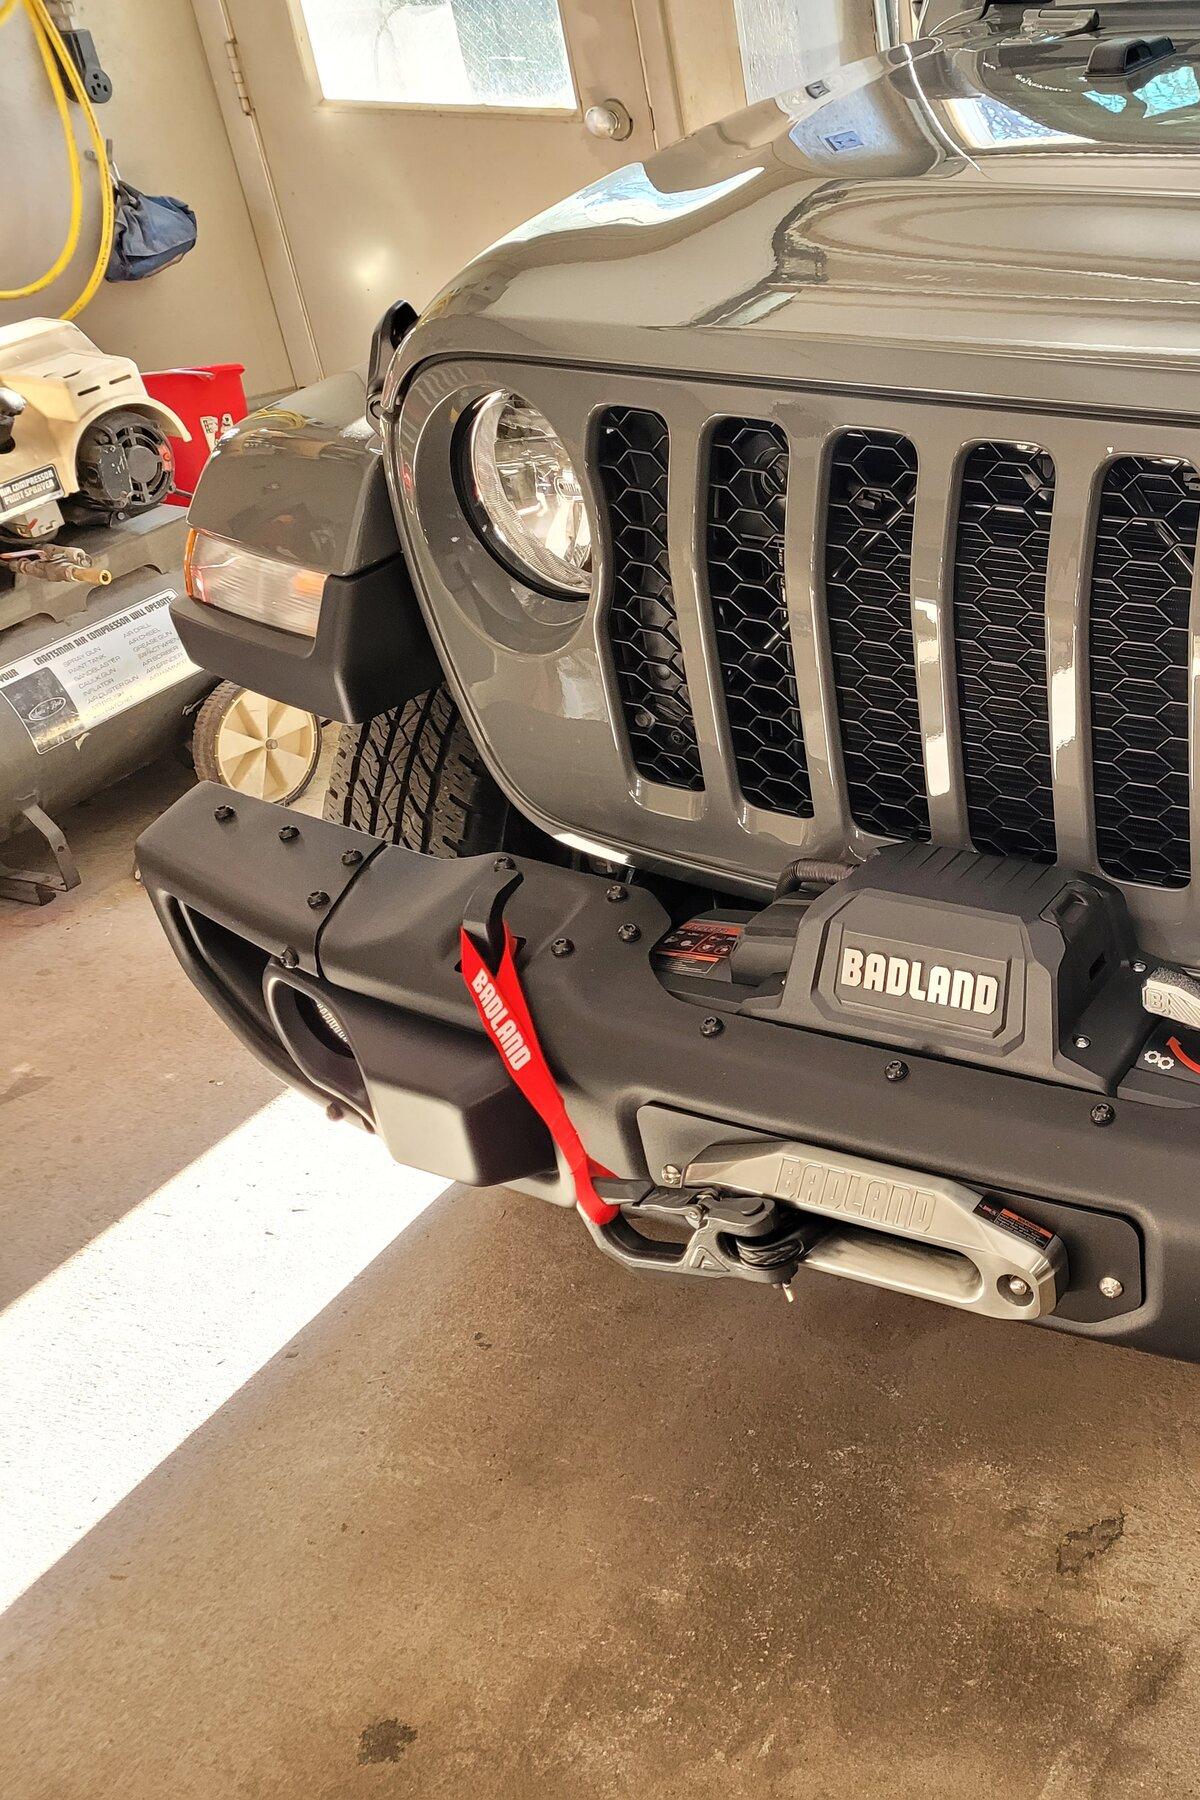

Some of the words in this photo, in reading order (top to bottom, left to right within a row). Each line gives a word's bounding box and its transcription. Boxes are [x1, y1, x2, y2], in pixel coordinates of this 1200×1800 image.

[11, 470, 55, 492] COMPRESSOR
[24, 479, 55, 497] SPRAYER
[0, 668, 19, 683] YOUR
[33, 642, 76, 666] CRAFTSMAN
[73, 636, 89, 648] AIR
[87, 616, 132, 641] COMPRESSOR
[130, 608, 147, 621] WILL
[841, 948, 999, 1015] BADLAND
[471, 968, 532, 1071] BADLAND
[774, 1155, 937, 1233] BADLAND
